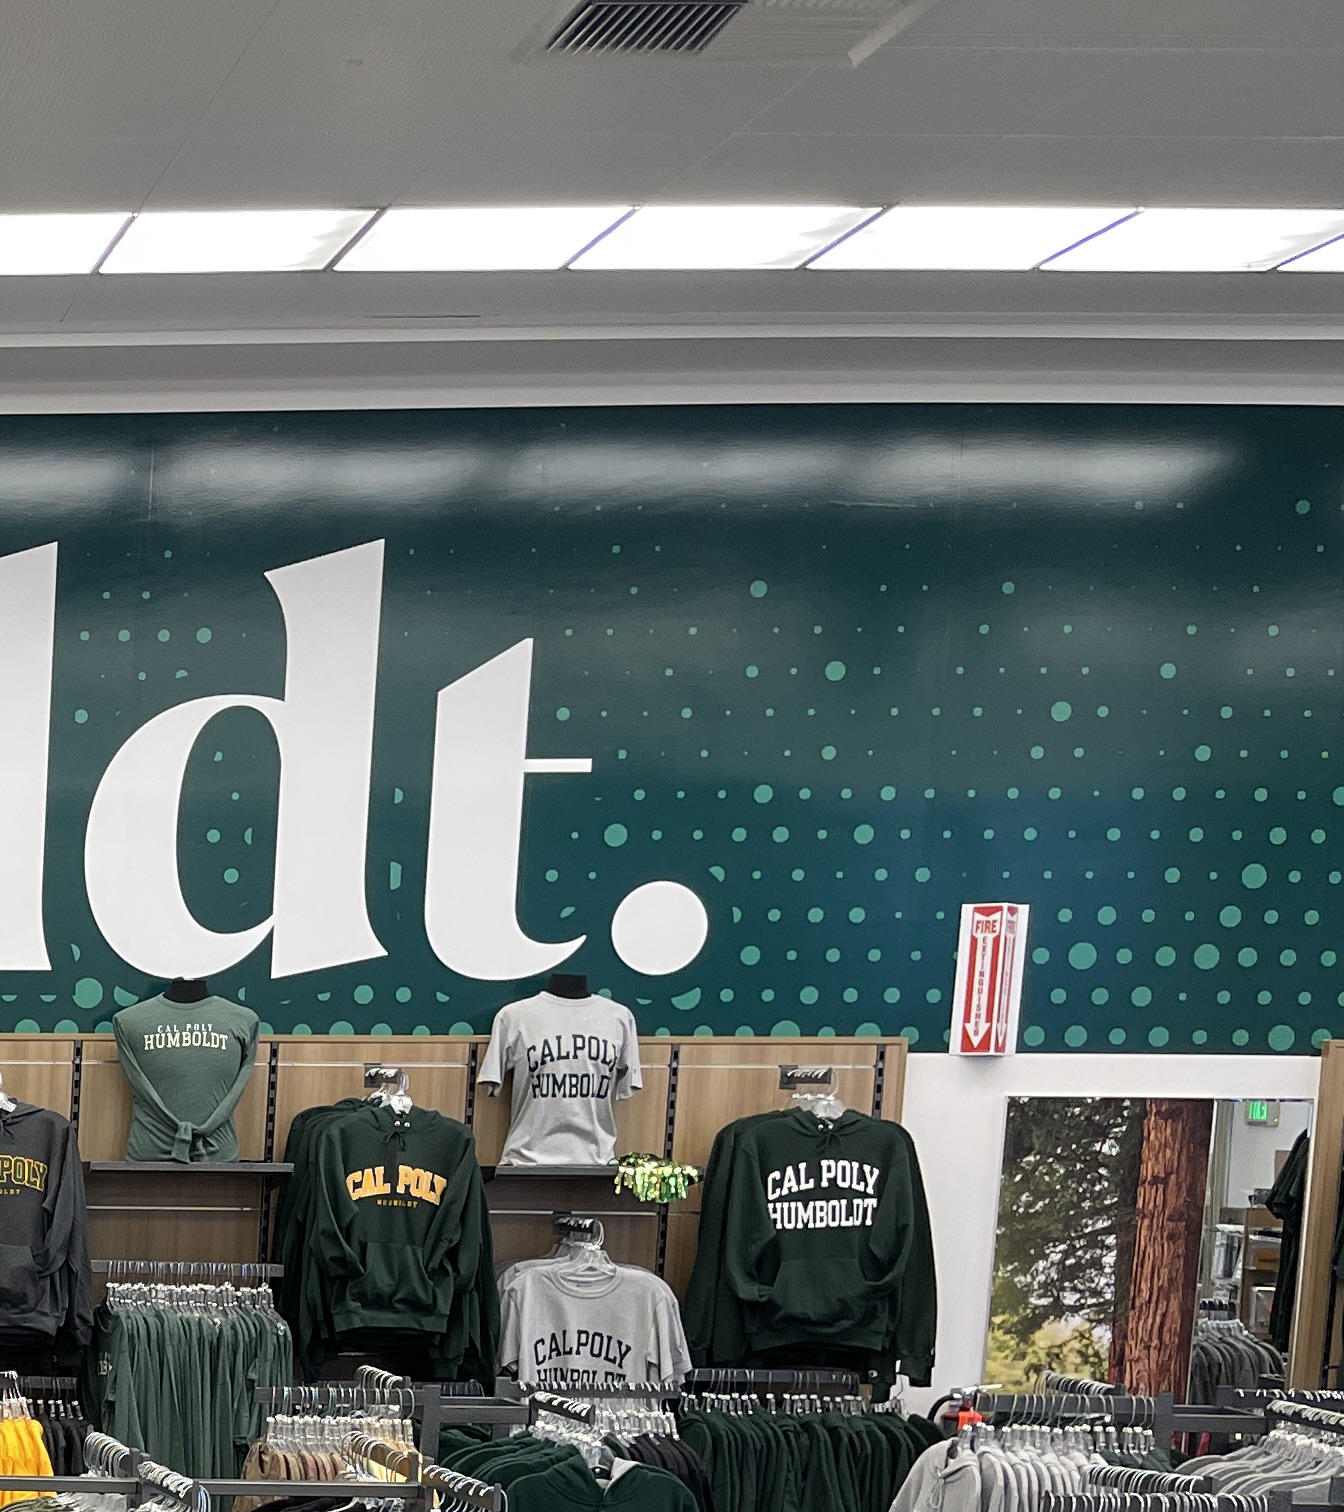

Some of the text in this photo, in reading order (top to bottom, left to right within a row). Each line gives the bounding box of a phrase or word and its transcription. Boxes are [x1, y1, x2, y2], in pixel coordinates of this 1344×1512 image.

[974, 920, 998, 934] FIRE
[973, 936, 989, 1037] EXTINGUISHER
[143, 1031, 229, 1051] HUMBOLDT
[157, 1023, 213, 1033] CAL POLY
[527, 1035, 571, 1073] CAL
[531, 1073, 612, 1099] HUMBOLD
[346, 1164, 448, 1206] CAL POLY
[767, 1159, 880, 1201] CAL POLY
[767, 1197, 878, 1230] HUMBOLDT
[534, 1329, 632, 1370] CAL POLY
